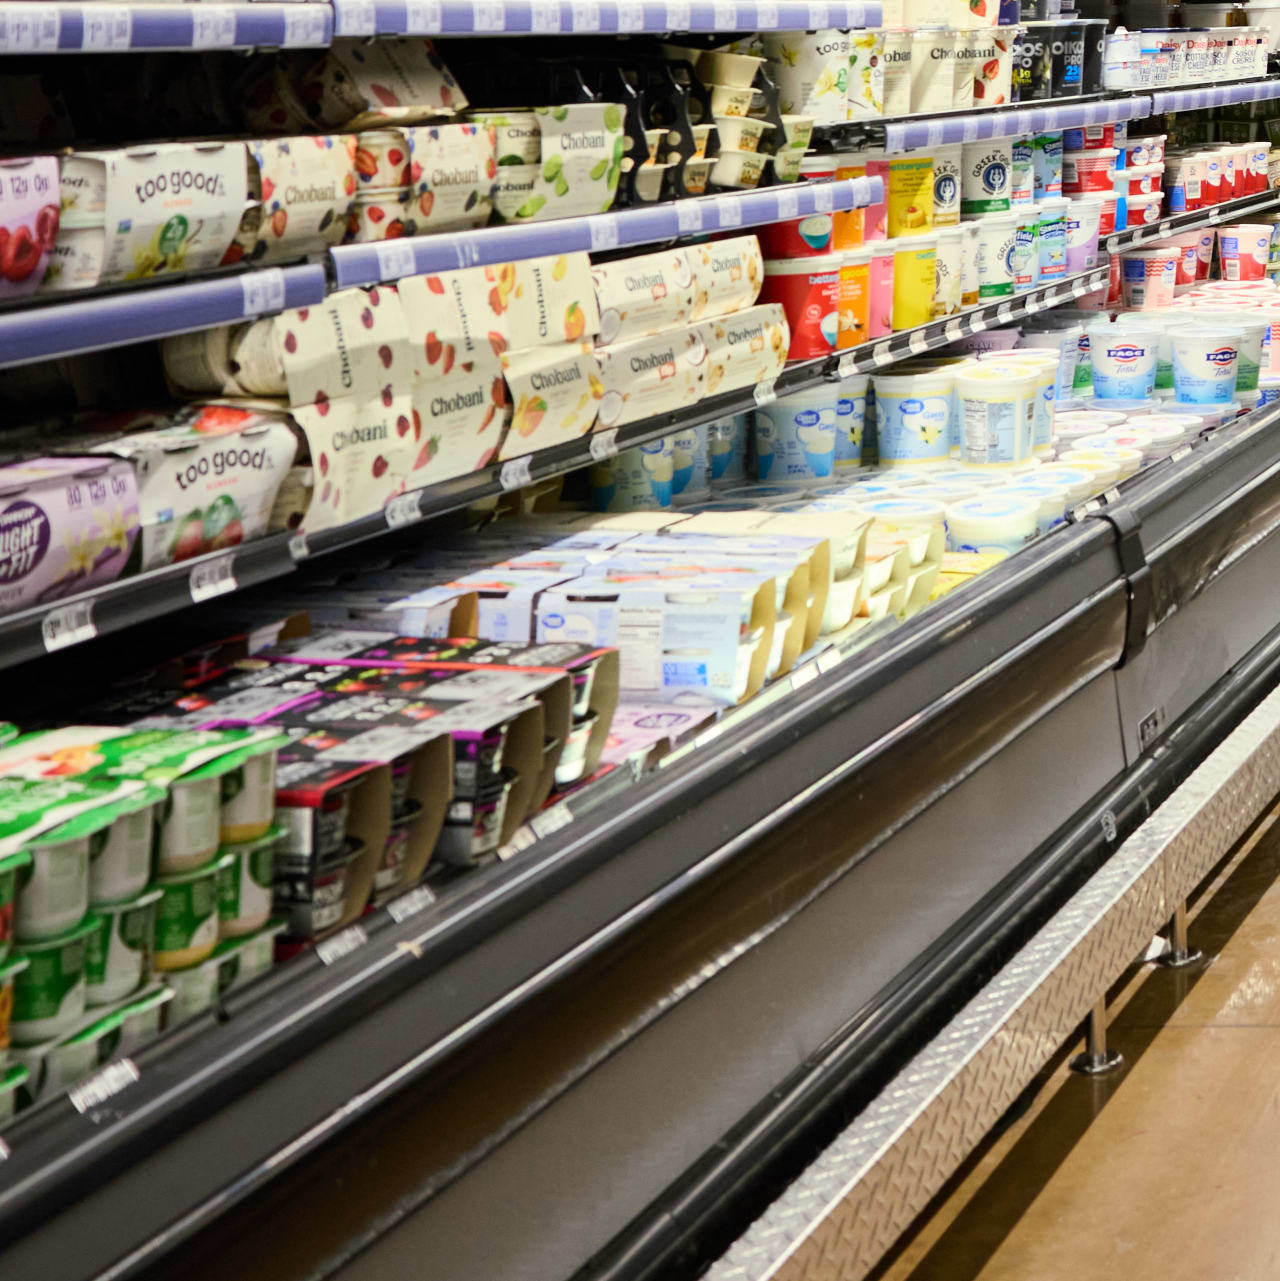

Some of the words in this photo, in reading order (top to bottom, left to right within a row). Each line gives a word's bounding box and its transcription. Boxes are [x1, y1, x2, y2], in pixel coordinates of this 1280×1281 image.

[1156, 39, 1183, 52] Daisy
[561, 132, 605, 151] Chobani
[136, 173, 167, 204] too
[171, 169, 220, 197] good
[431, 165, 480, 188] Chobani
[285, 179, 336, 206] Chobani
[712, 253, 742, 273] Chobani
[625, 270, 665, 293] Chobani
[452, 279, 475, 352] Chobani
[534, 268, 547, 338] Chobani
[330, 308, 353, 388] Chobani
[728, 323, 763, 346] Chobani
[630, 348, 675, 373] Chobani
[530, 362, 582, 392] Chobani
[431, 386, 484, 417] Chobani
[332, 422, 388, 452] Chobani
[176, 458, 209, 490] too
[214, 448, 266, 476] good
